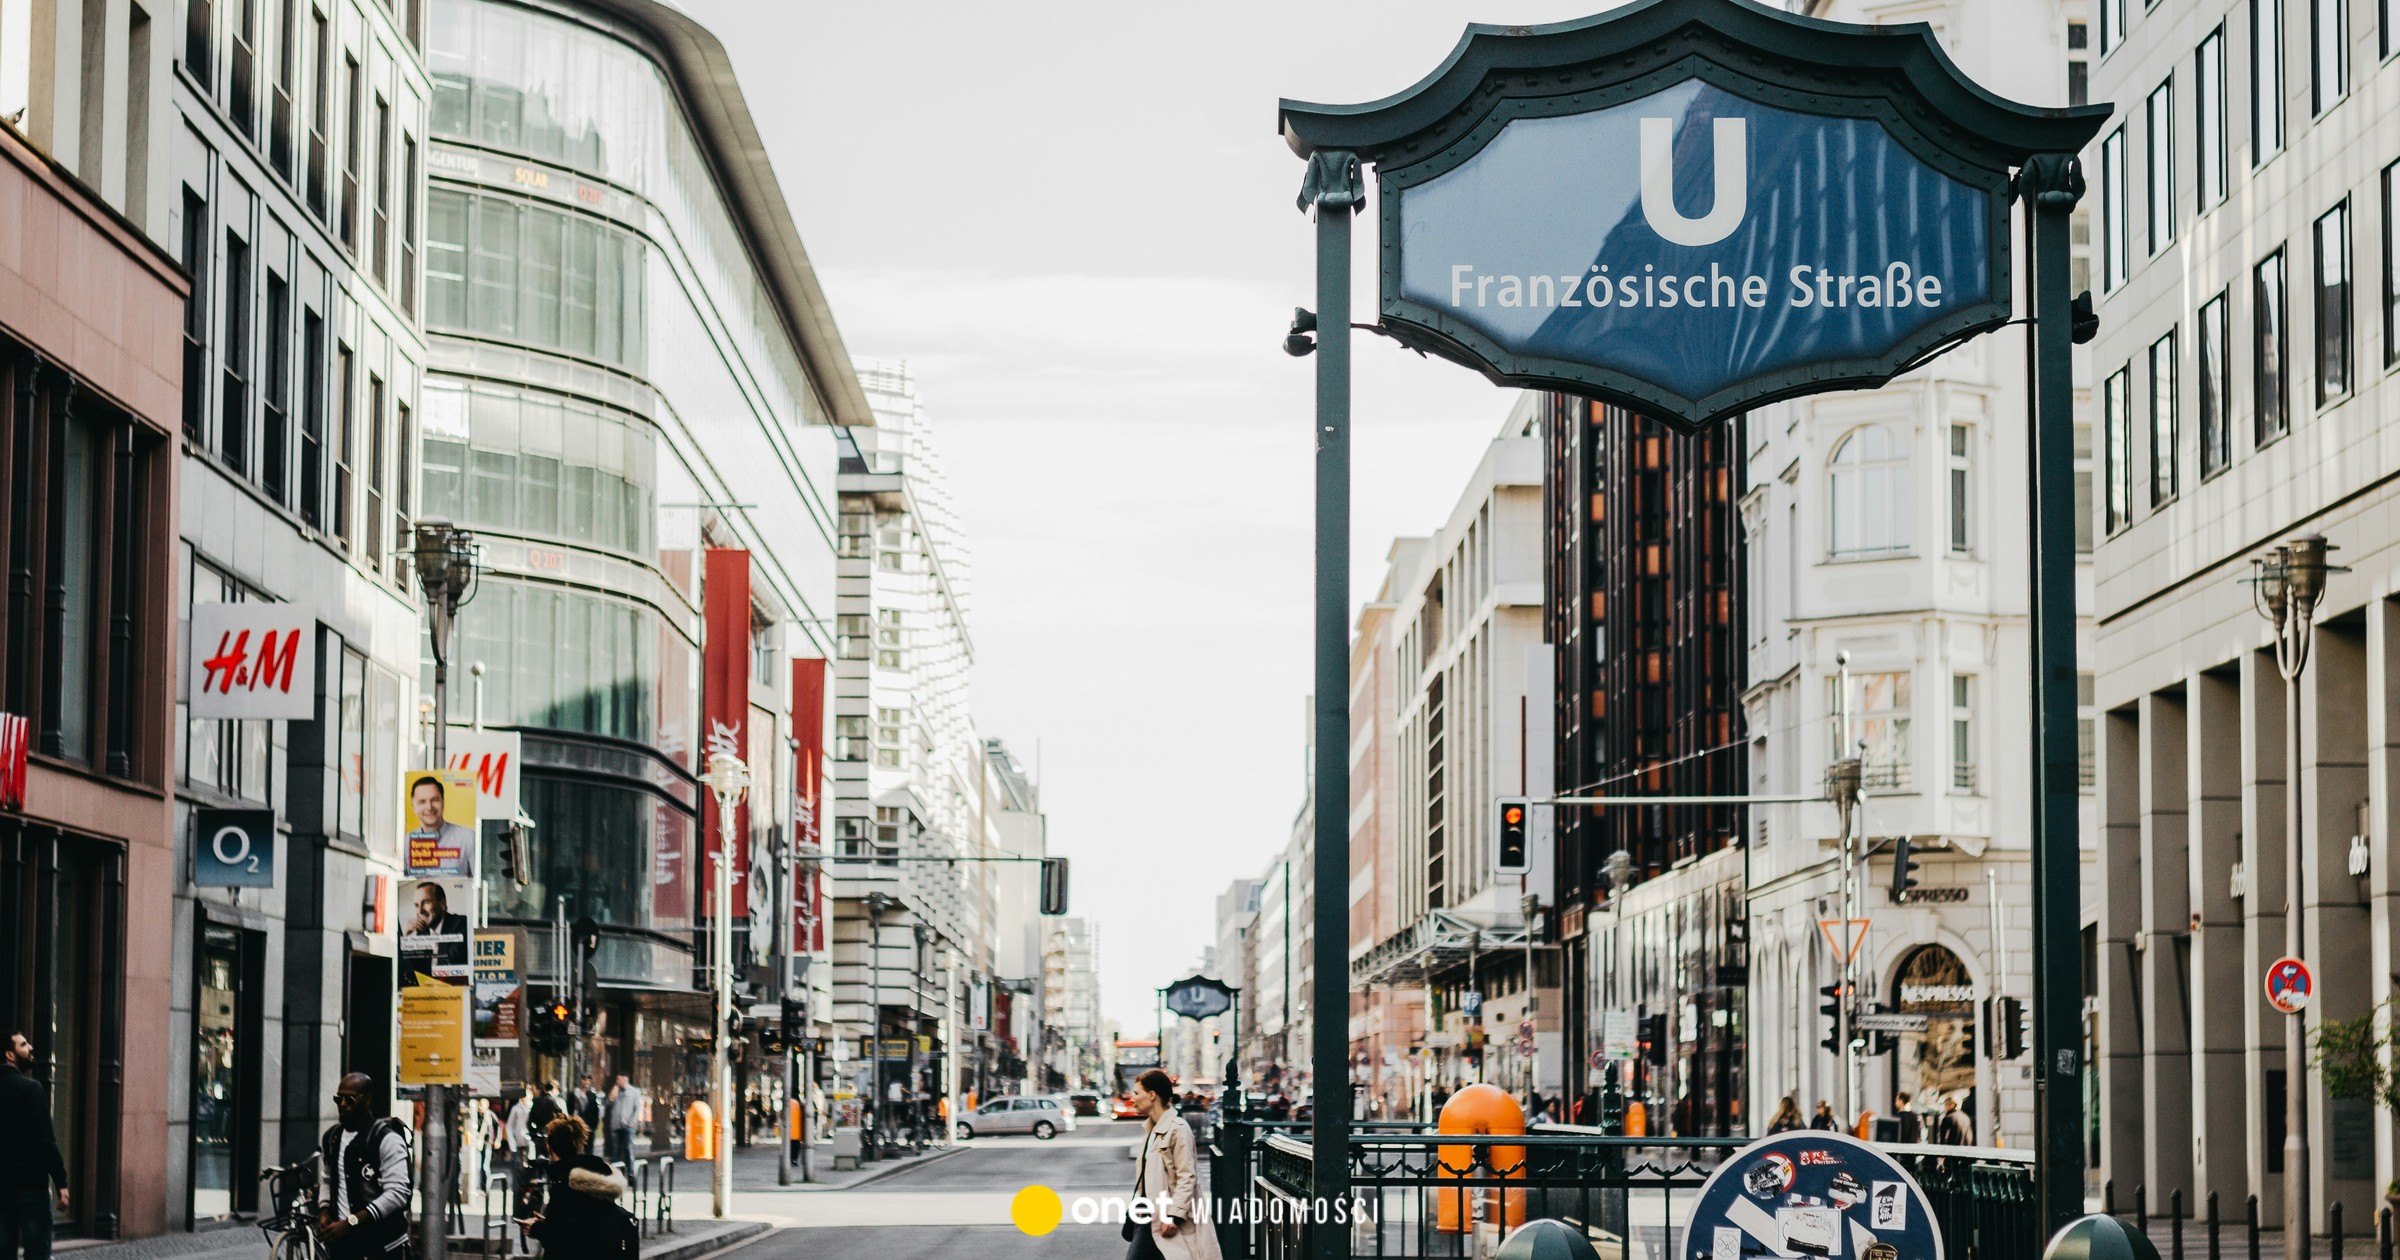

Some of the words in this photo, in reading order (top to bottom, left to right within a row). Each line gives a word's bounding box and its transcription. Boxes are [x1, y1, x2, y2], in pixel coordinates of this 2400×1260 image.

[515, 166, 548, 188] SOLAR
[1640, 117, 1747, 246] U
[1451, 262, 1768, 308] Französische
[1790, 261, 1942, 308] Straße
[203, 628, 300, 694] H&M
[1901, 984, 1975, 1004] NESPRESSO
